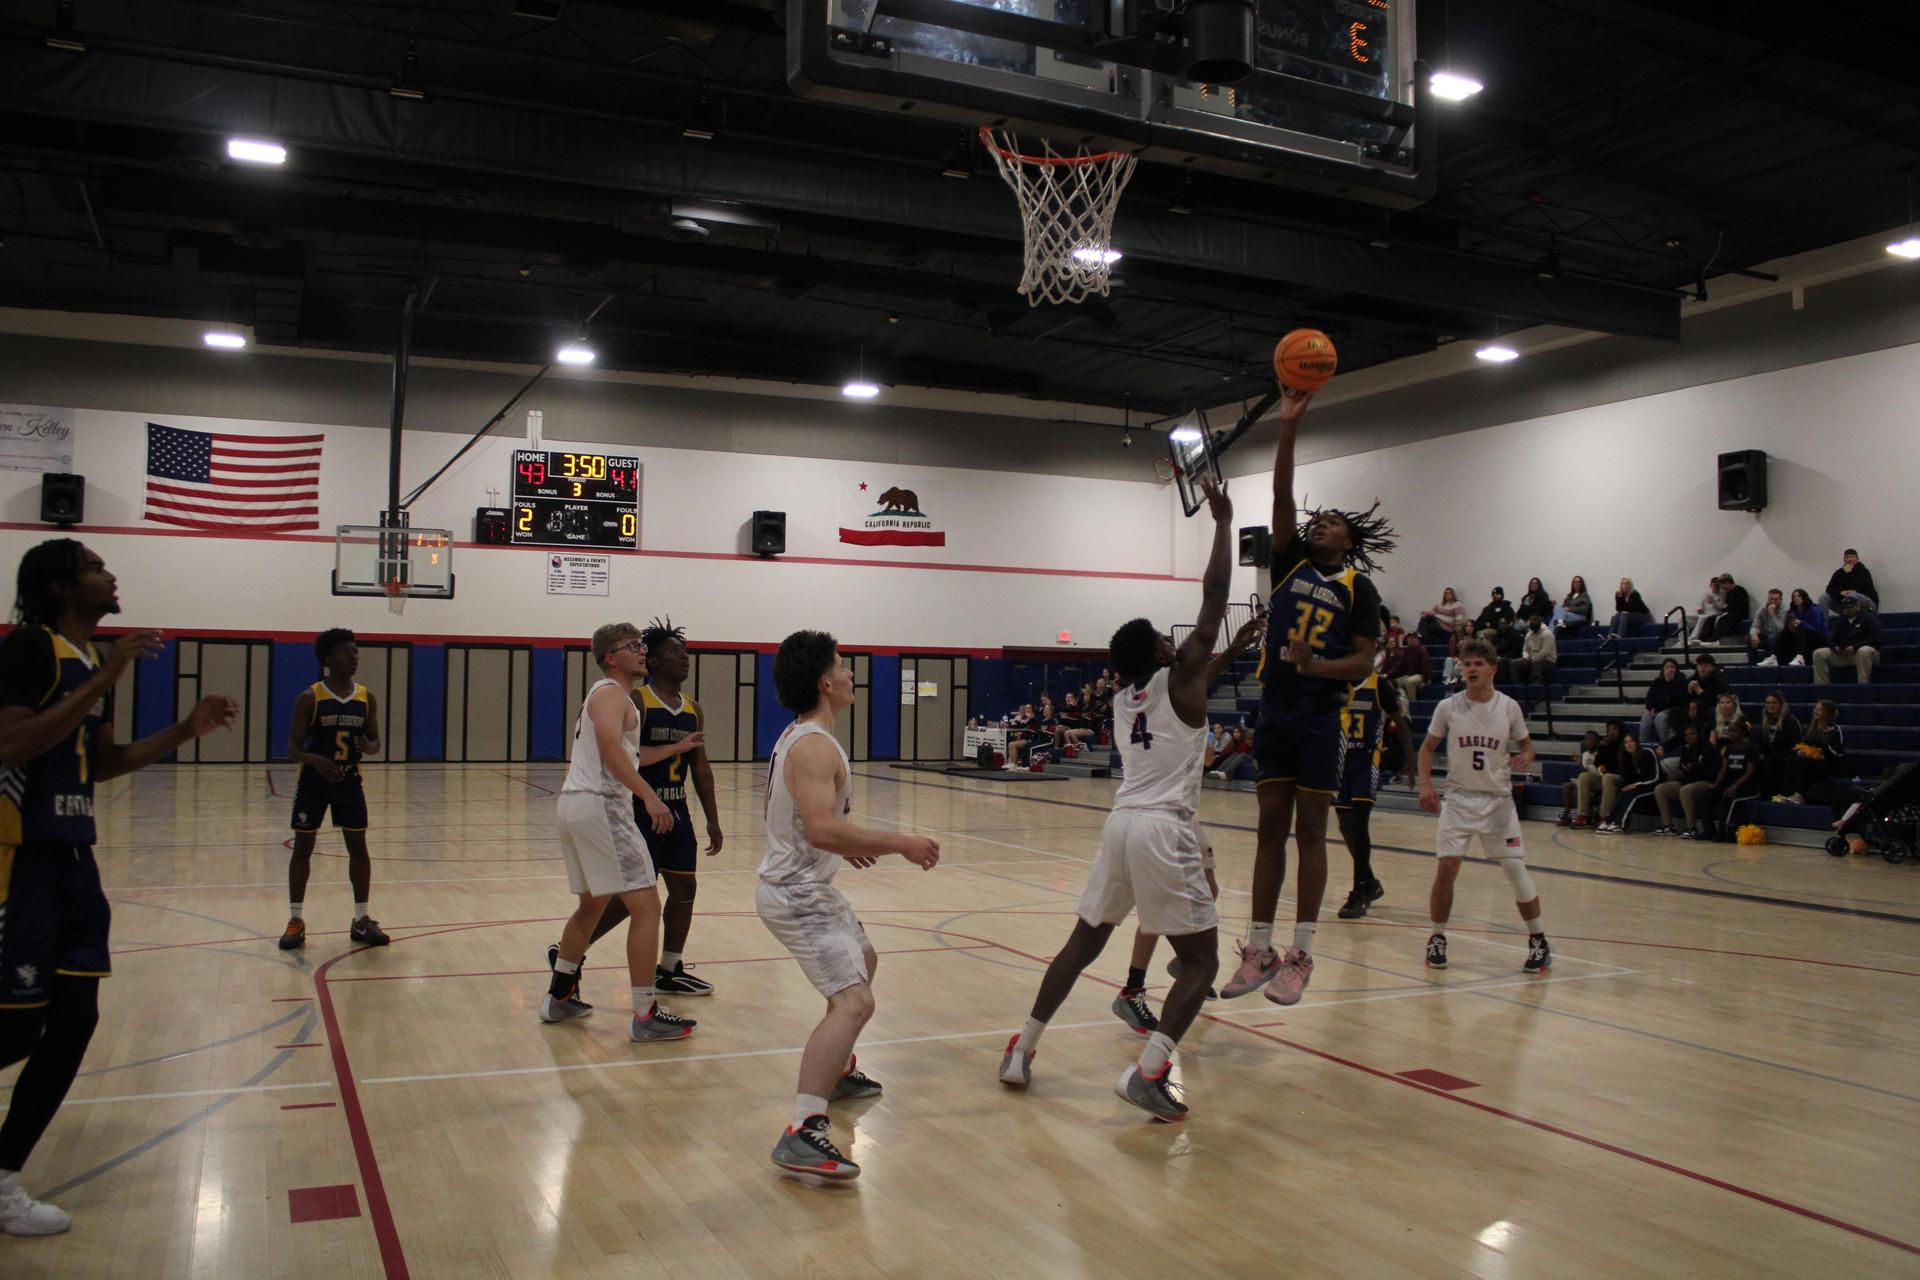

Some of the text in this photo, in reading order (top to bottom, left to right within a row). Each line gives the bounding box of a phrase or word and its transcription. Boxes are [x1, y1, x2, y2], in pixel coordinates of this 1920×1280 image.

[517, 453, 545, 463] HOME
[563, 454, 605, 478] 3:50
[608, 458, 638, 468] GUEST
[519, 463, 545, 485] 43
[611, 468, 637, 490] 41
[573, 482, 582, 497] 3
[519, 508, 533, 531] 2
[622, 514, 635, 536] 0
[864, 520, 931, 529] CALIFORNIA REPUBLIC
[1287, 601, 1335, 649] 32
[1130, 712, 1154, 750] 4
[334, 731, 350, 761] 5
[1458, 736, 1501, 750] EAGLES
[75, 725, 88, 784] 1
[1472, 751, 1485, 771] 5
